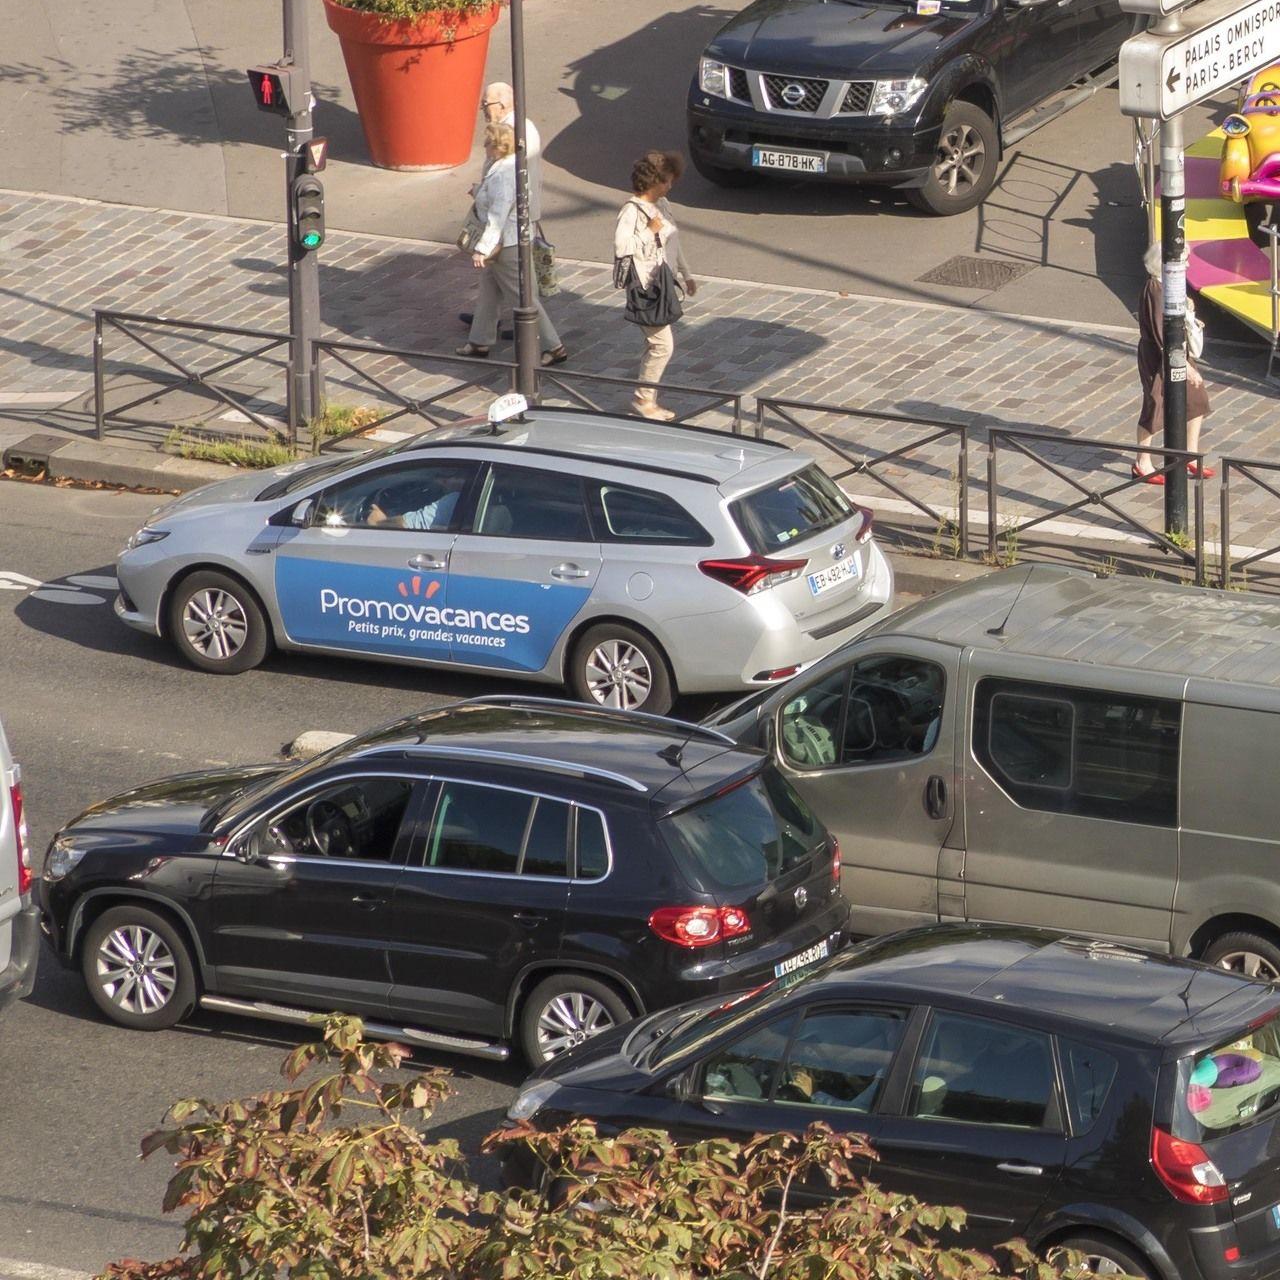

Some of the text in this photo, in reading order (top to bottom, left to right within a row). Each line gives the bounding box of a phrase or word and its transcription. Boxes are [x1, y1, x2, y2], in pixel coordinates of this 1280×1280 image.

[1185, 34, 1221, 69] PALAIS
[761, 152, 815, 171] AG-878-HK
[320, 588, 531, 634] Promovacances
[348, 620, 506, 648] Petits prix, grandes vacances
